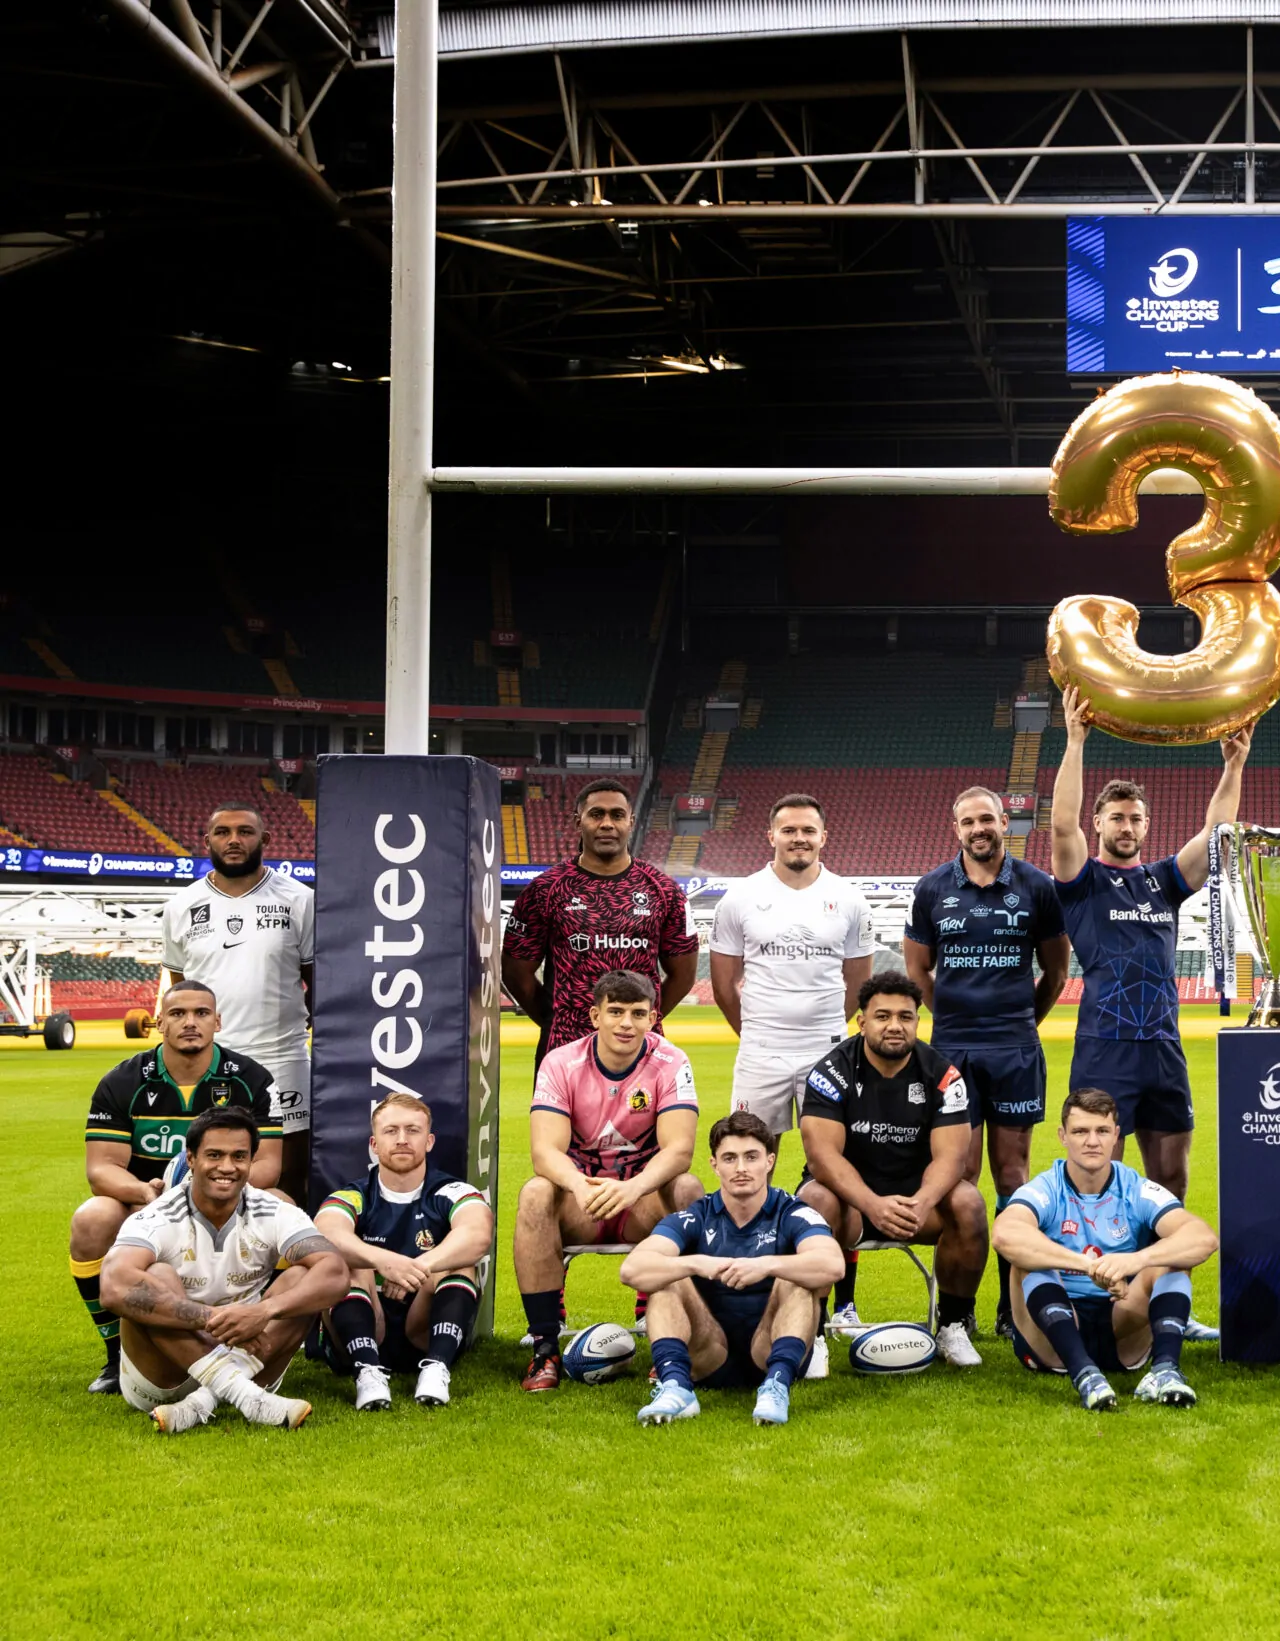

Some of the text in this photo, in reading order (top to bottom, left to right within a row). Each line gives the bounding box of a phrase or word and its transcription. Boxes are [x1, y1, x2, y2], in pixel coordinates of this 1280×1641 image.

[1142, 298, 1219, 310] Investec
[1126, 309, 1219, 321] CHAMPIONS
[1155, 321, 1188, 332] CUP
[272, 697, 323, 711] Principality
[278, 760, 297, 770] 436
[688, 797, 705, 807] 438
[1009, 797, 1025, 806] 439
[104, 860, 157, 871] CHAMPIONS
[156, 861, 175, 872] CUP
[256, 905, 291, 915] TOULON
[1110, 909, 1140, 921] Bank
[265, 919, 291, 930] TPM
[936, 917, 967, 933] TARN
[1211, 891, 1223, 951] CHAMPIONS
[994, 928, 1028, 937] randstad
[759, 942, 833, 961] Kingspan
[944, 944, 1021, 954] Laboratoires
[1226, 926, 1236, 972] Investec
[944, 956, 1021, 967] PIERRE FABRE
[1213, 951, 1222, 970] CUP
[828, 1065, 849, 1090] leidos
[880, 1341, 925, 1352] Investec
